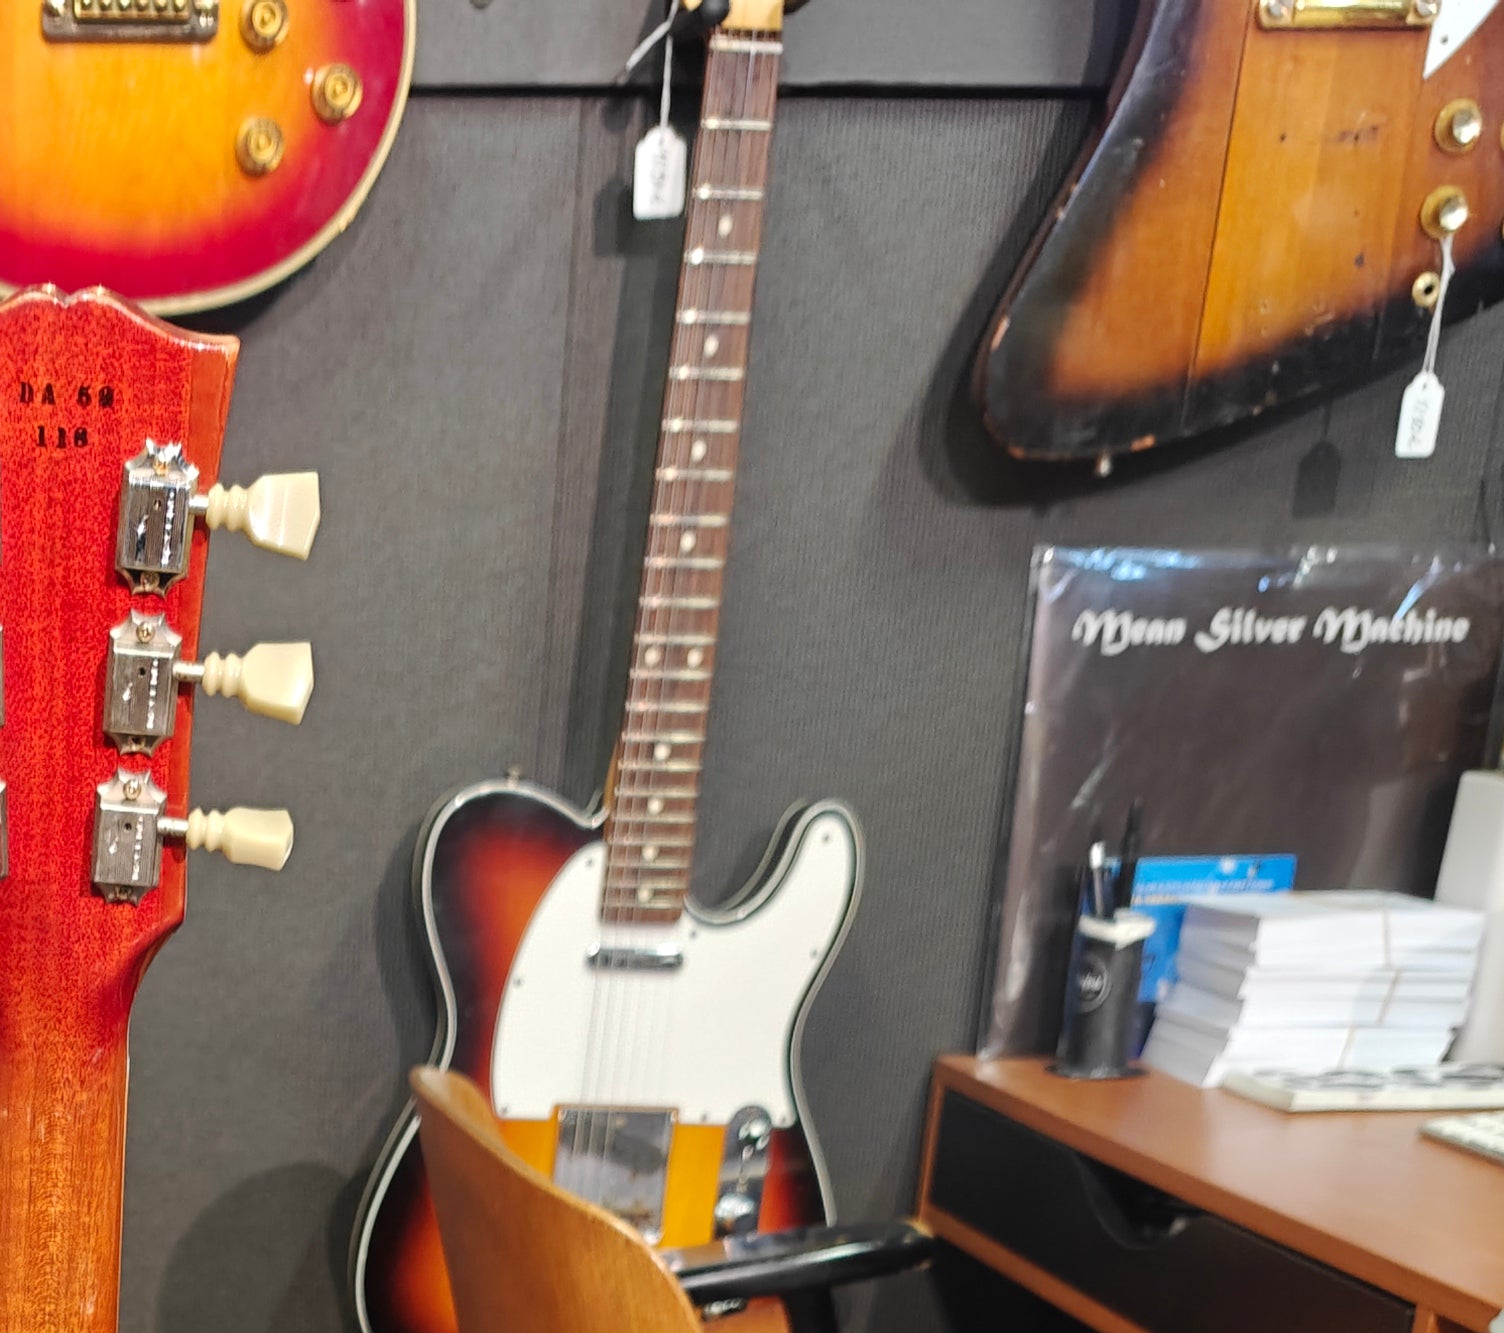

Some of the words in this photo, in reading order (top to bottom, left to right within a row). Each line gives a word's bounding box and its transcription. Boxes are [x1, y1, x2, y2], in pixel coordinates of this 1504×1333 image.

[20, 382, 56, 405] DA
[36, 425, 88, 448] 118
[1072, 608, 1187, 656] Mean
[1194, 606, 1307, 653] Silver
[1312, 607, 1470, 655] Machine
